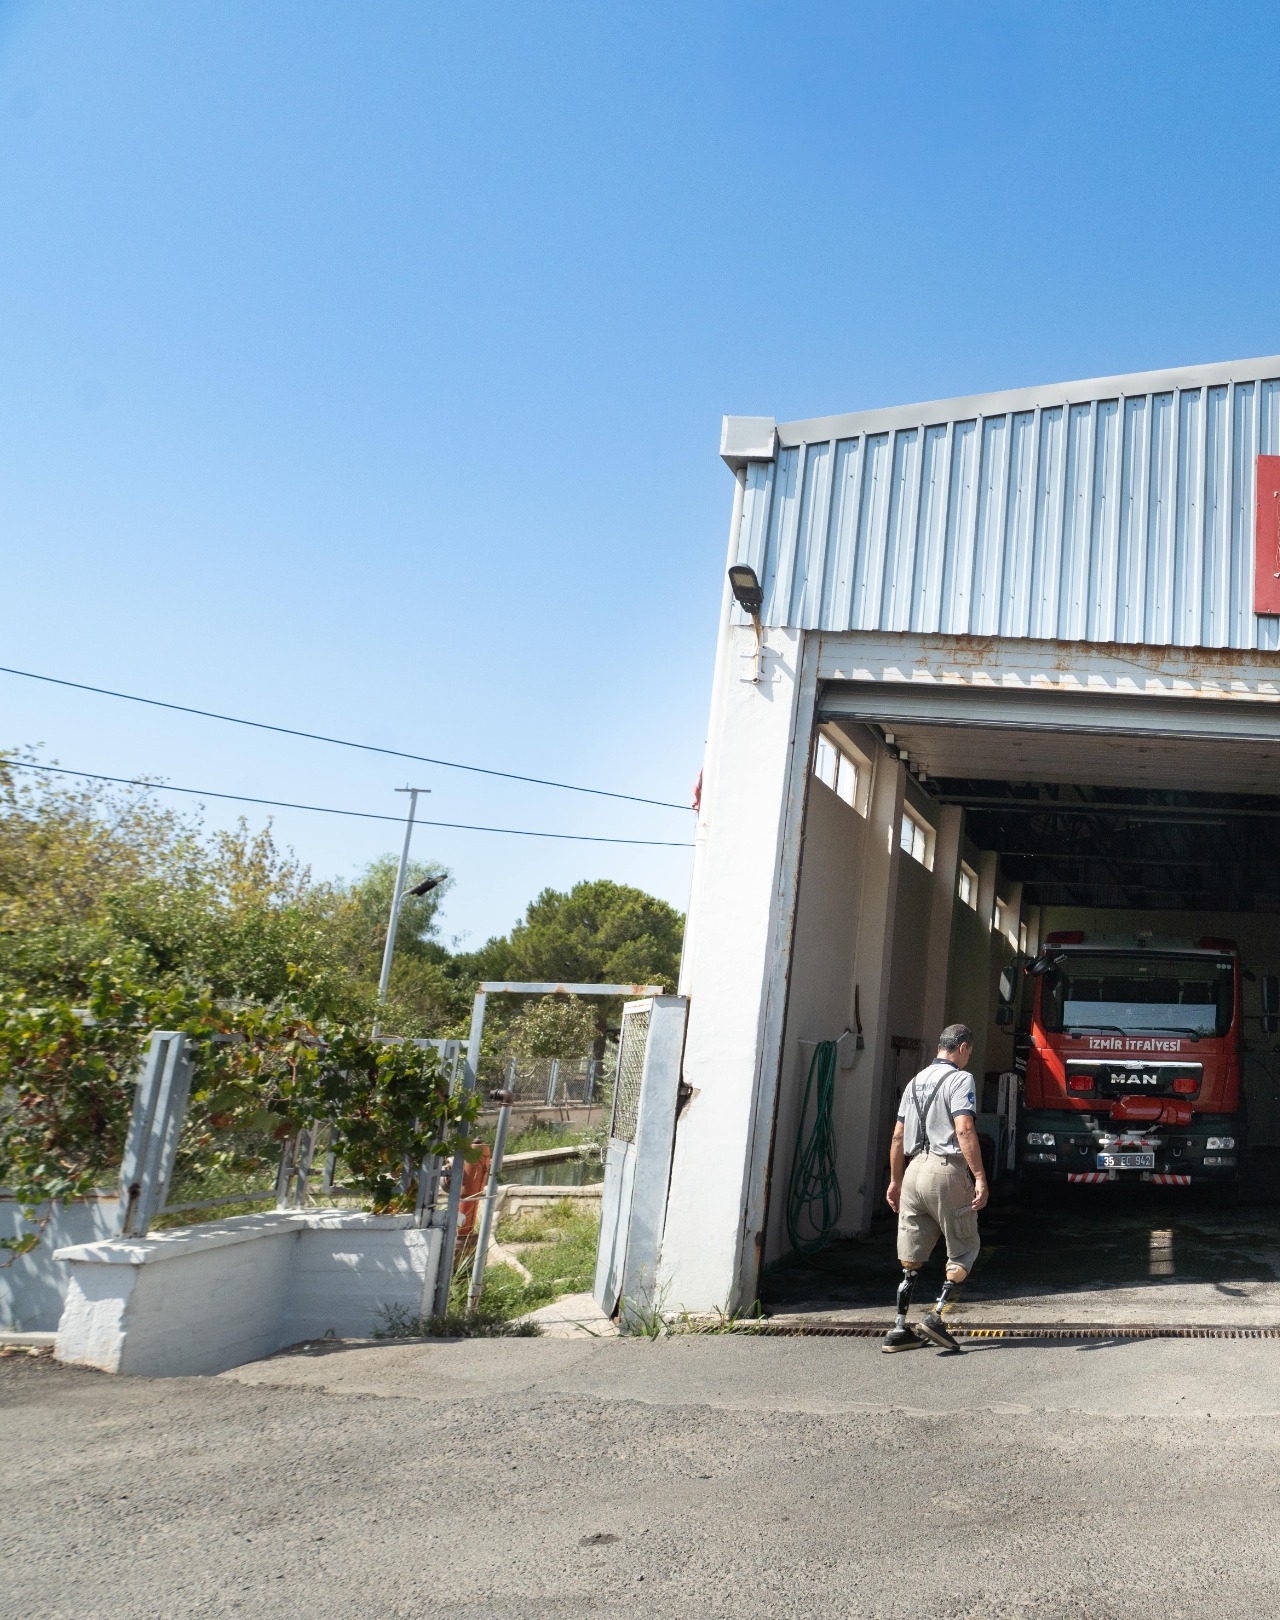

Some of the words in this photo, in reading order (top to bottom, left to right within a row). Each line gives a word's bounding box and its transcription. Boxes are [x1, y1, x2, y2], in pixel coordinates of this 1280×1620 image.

[1089, 1037, 1123, 1050] İZMİR
[1125, 1038, 1181, 1052] İTFAİYESİ
[1110, 1073, 1158, 1085] MAN
[1103, 1156, 1115, 1167] 35
[1120, 1156, 1131, 1166] EC
[1135, 1155, 1151, 1166] 942
